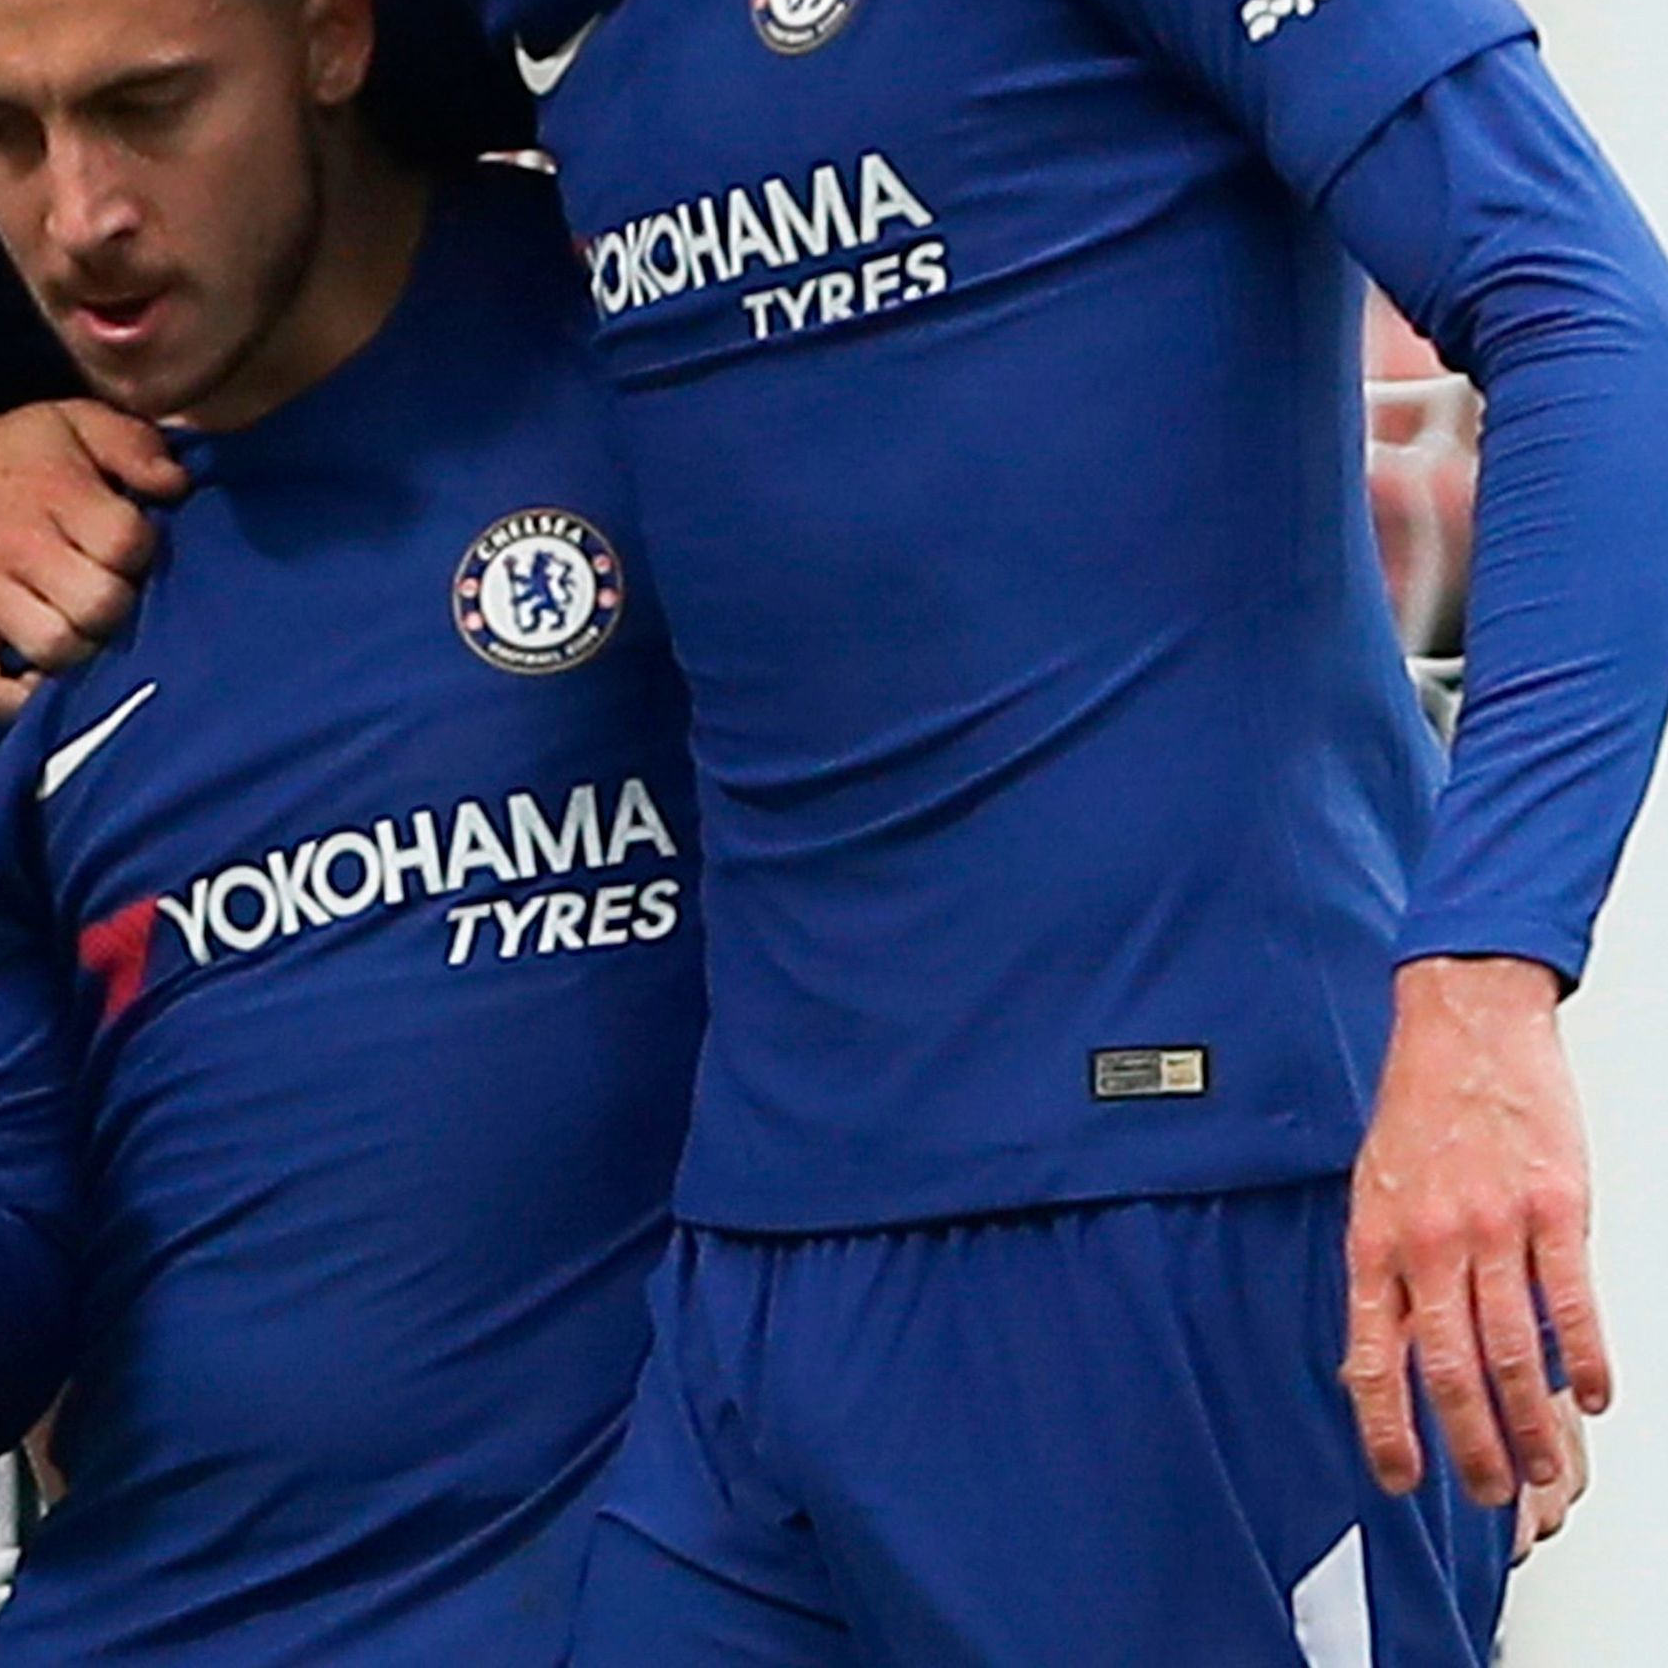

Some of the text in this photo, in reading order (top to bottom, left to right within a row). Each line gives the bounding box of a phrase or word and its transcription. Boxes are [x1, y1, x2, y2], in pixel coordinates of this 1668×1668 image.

[742, 241, 948, 340] TYRES
[476, 515, 583, 562] CHELSEA
[159, 779, 678, 966] YOKOHAMA
[446, 879, 679, 965] TYRES
